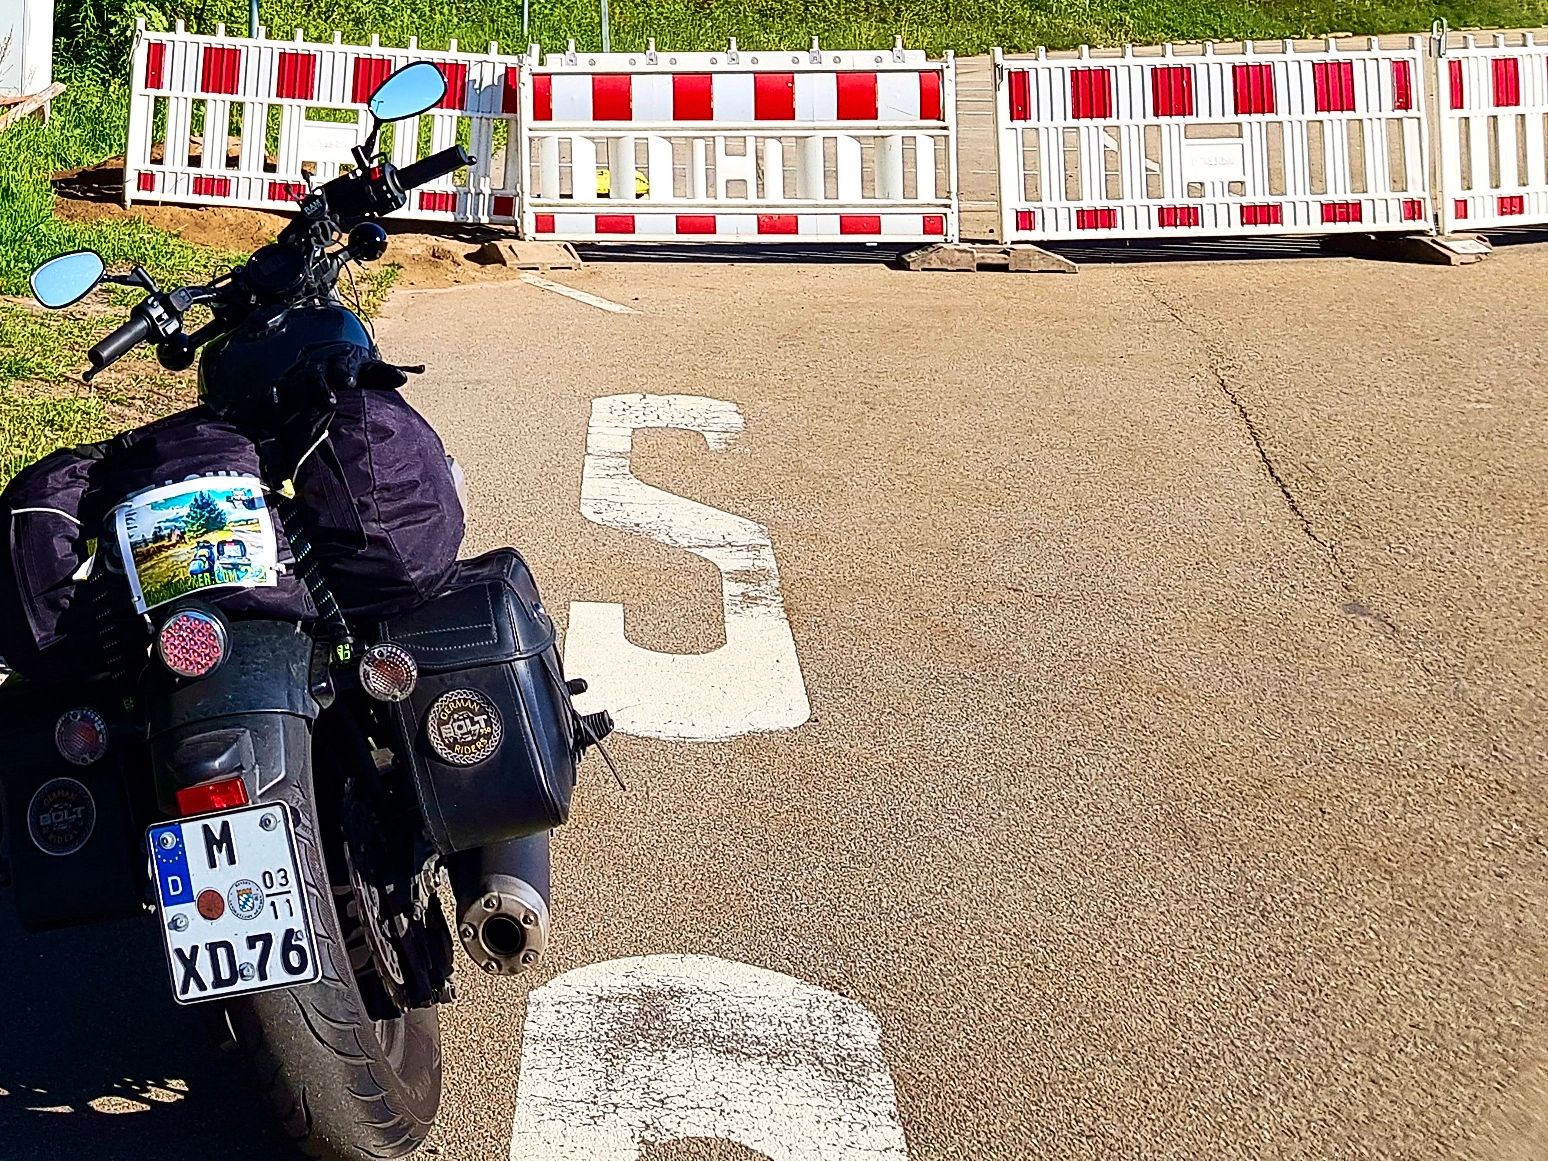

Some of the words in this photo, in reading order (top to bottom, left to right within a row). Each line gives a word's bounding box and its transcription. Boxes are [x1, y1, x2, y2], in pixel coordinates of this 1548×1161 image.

[454, 737, 488, 754] RIDERS
[202, 820, 237, 869] M
[168, 875, 183, 896] D
[262, 868, 290, 890] 03
[270, 898, 294, 920] 11
